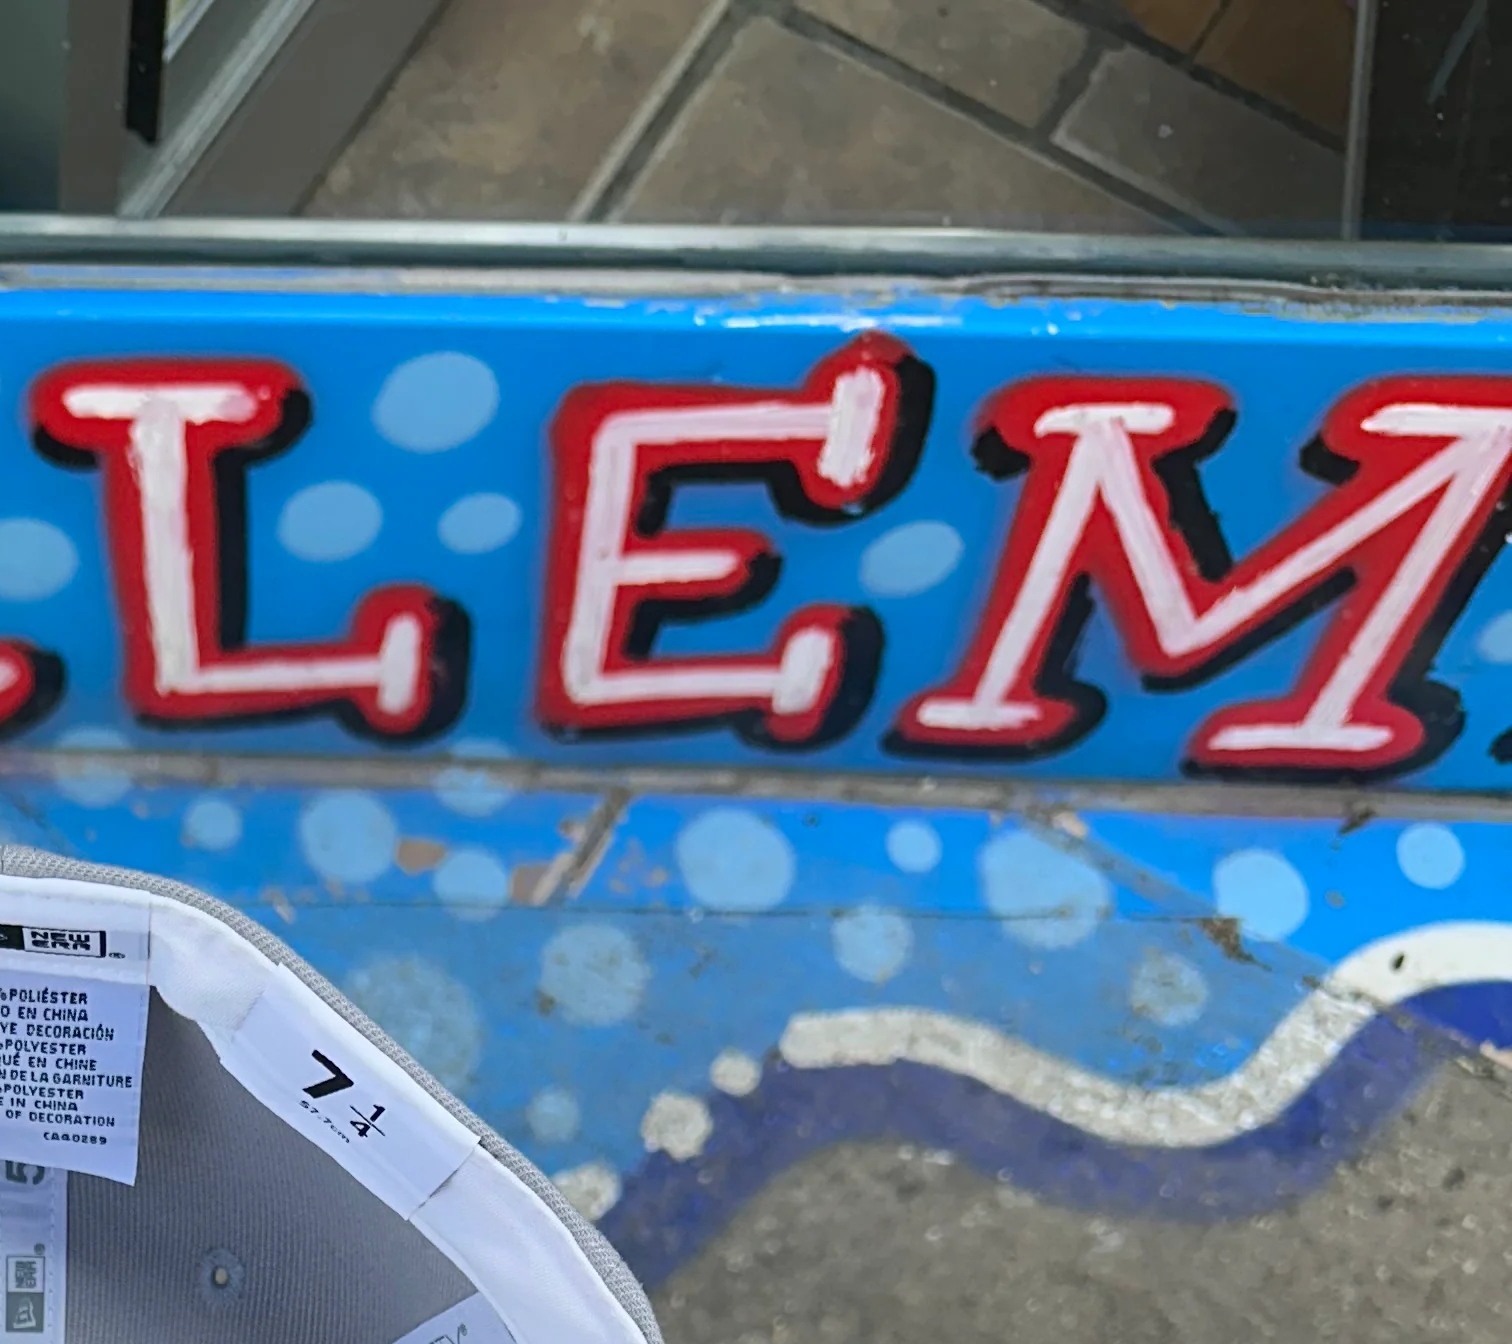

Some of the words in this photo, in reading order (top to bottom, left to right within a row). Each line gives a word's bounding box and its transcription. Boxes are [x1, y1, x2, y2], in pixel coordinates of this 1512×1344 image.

[30, 930, 91, 943] NEW
[18, 1006, 37, 1019] EN
[43, 1008, 88, 1021] CHINA
[26, 1023, 114, 1041] DECORACIÓN
[28, 1056, 47, 1068] EN
[55, 1057, 97, 1071] CHINE
[10, 1069, 27, 1081] DE
[31, 1071, 48, 1084] LA
[52, 1072, 132, 1088] GARNITURE
[302, 1049, 354, 1099] 7
[10, 1096, 26, 1108] IN
[34, 1098, 78, 1112] CHINA
[5, 1109, 22, 1122] OF
[29, 1111, 116, 1128] DECORATION
